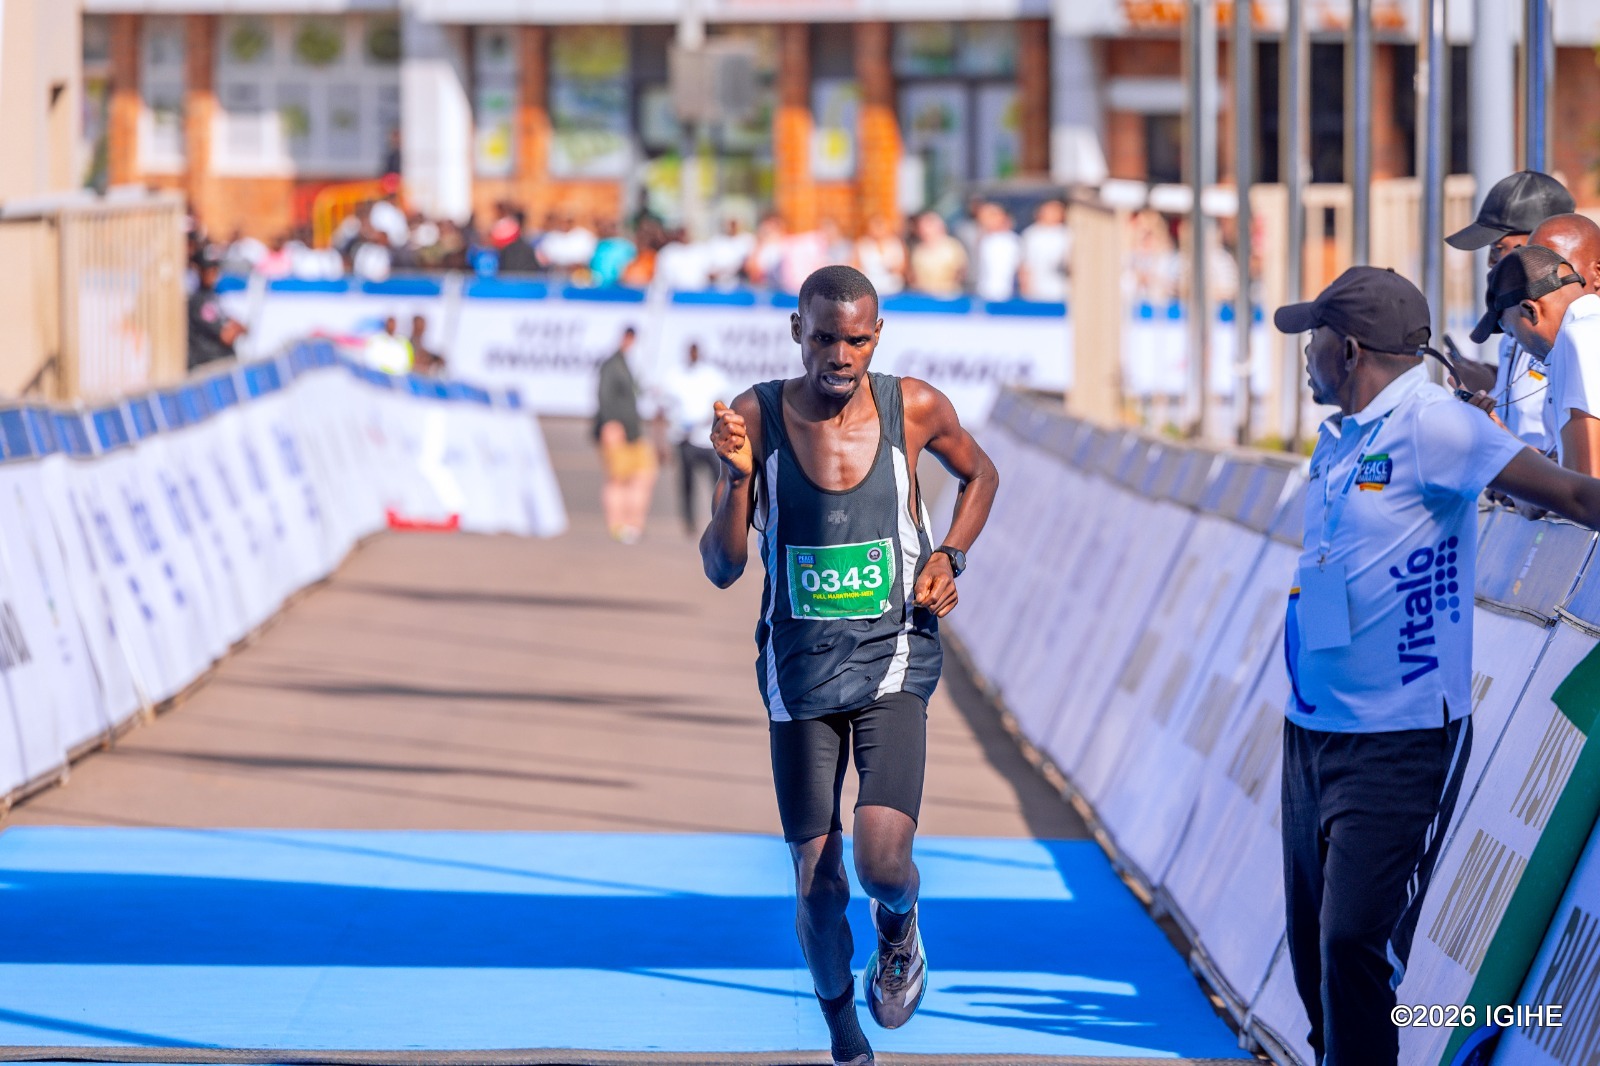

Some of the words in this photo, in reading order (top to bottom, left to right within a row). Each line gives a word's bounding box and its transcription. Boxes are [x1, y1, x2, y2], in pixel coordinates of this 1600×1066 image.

[1361, 461, 1388, 475] PEACE
[801, 565, 883, 592] 0343
[1508, 706, 1588, 832] VISIT
